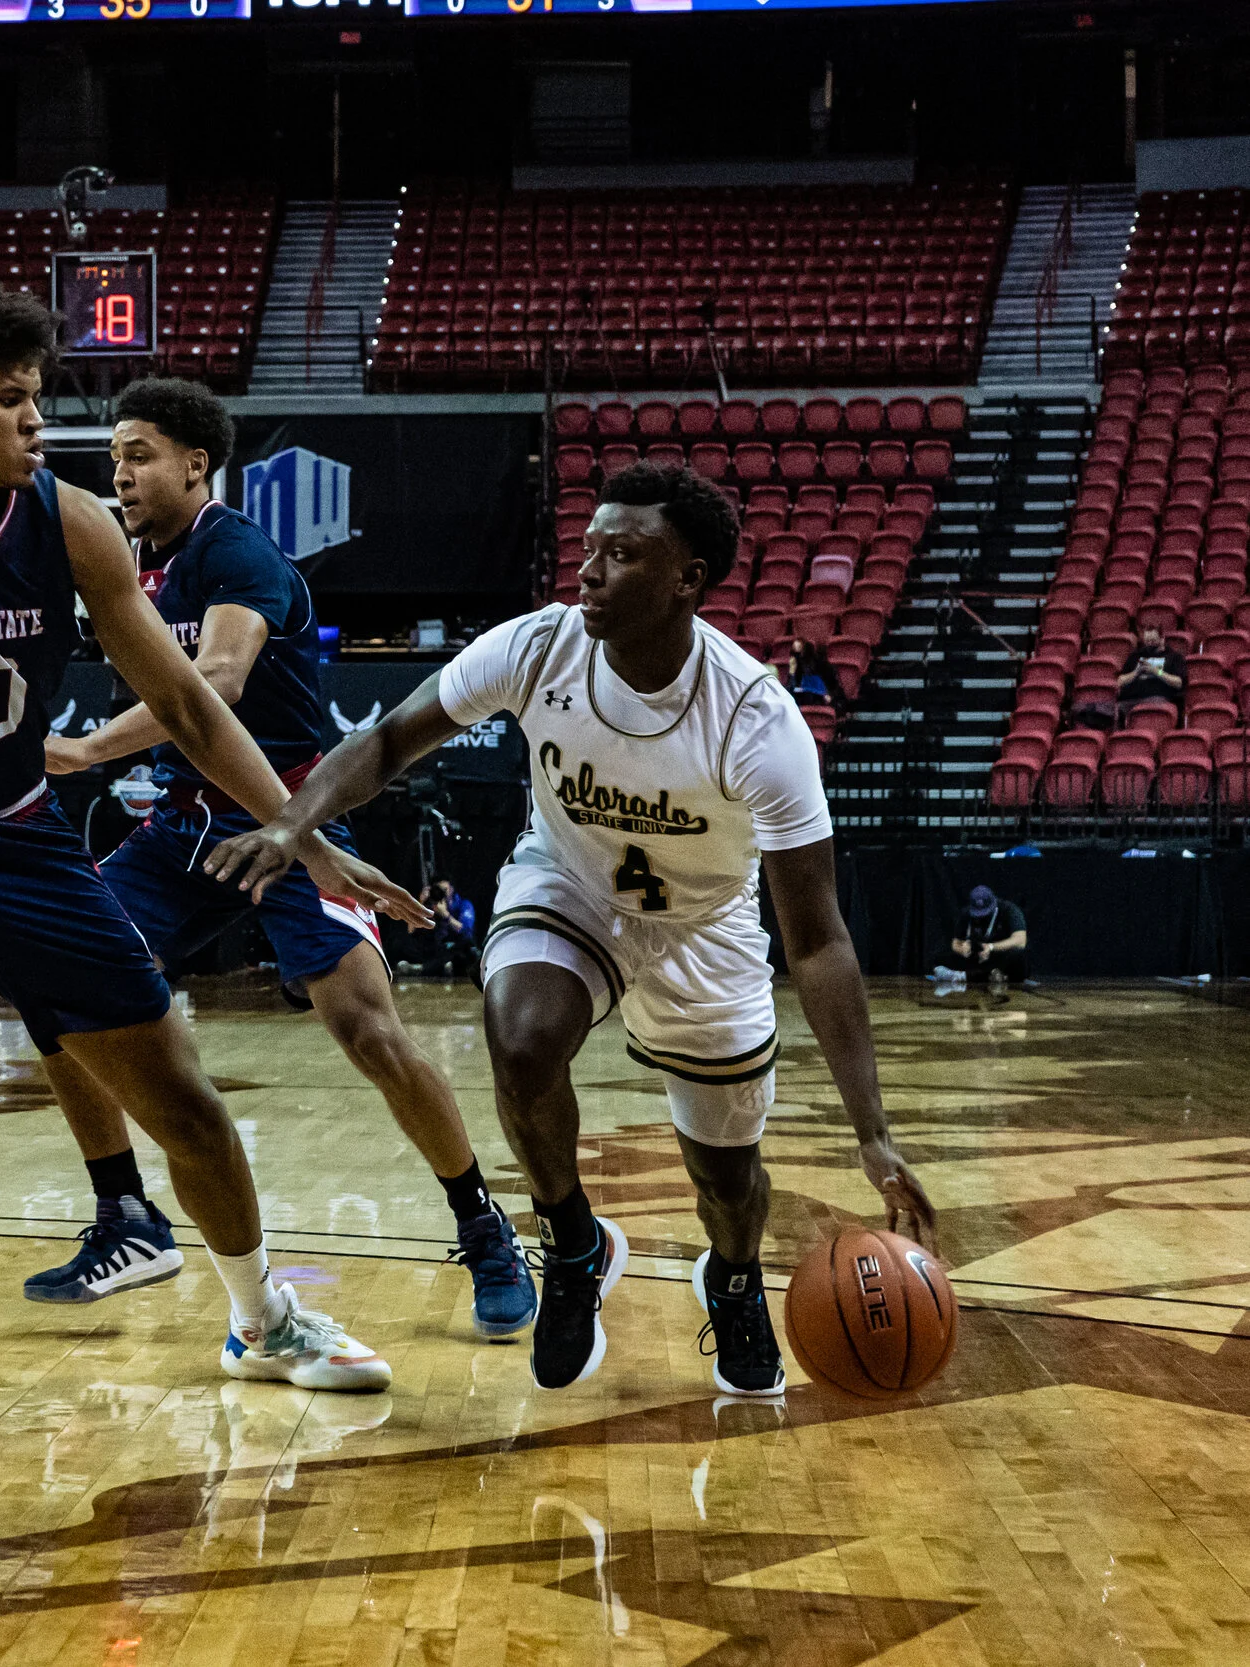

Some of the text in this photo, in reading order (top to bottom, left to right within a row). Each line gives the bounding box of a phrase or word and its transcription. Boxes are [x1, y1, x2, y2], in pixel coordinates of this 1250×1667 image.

[95, 293, 136, 343] 18
[539, 740, 695, 825] Colorado
[578, 810, 668, 835] STATE UNIV
[614, 843, 670, 912] 4
[854, 1254, 893, 1335] ELITE
